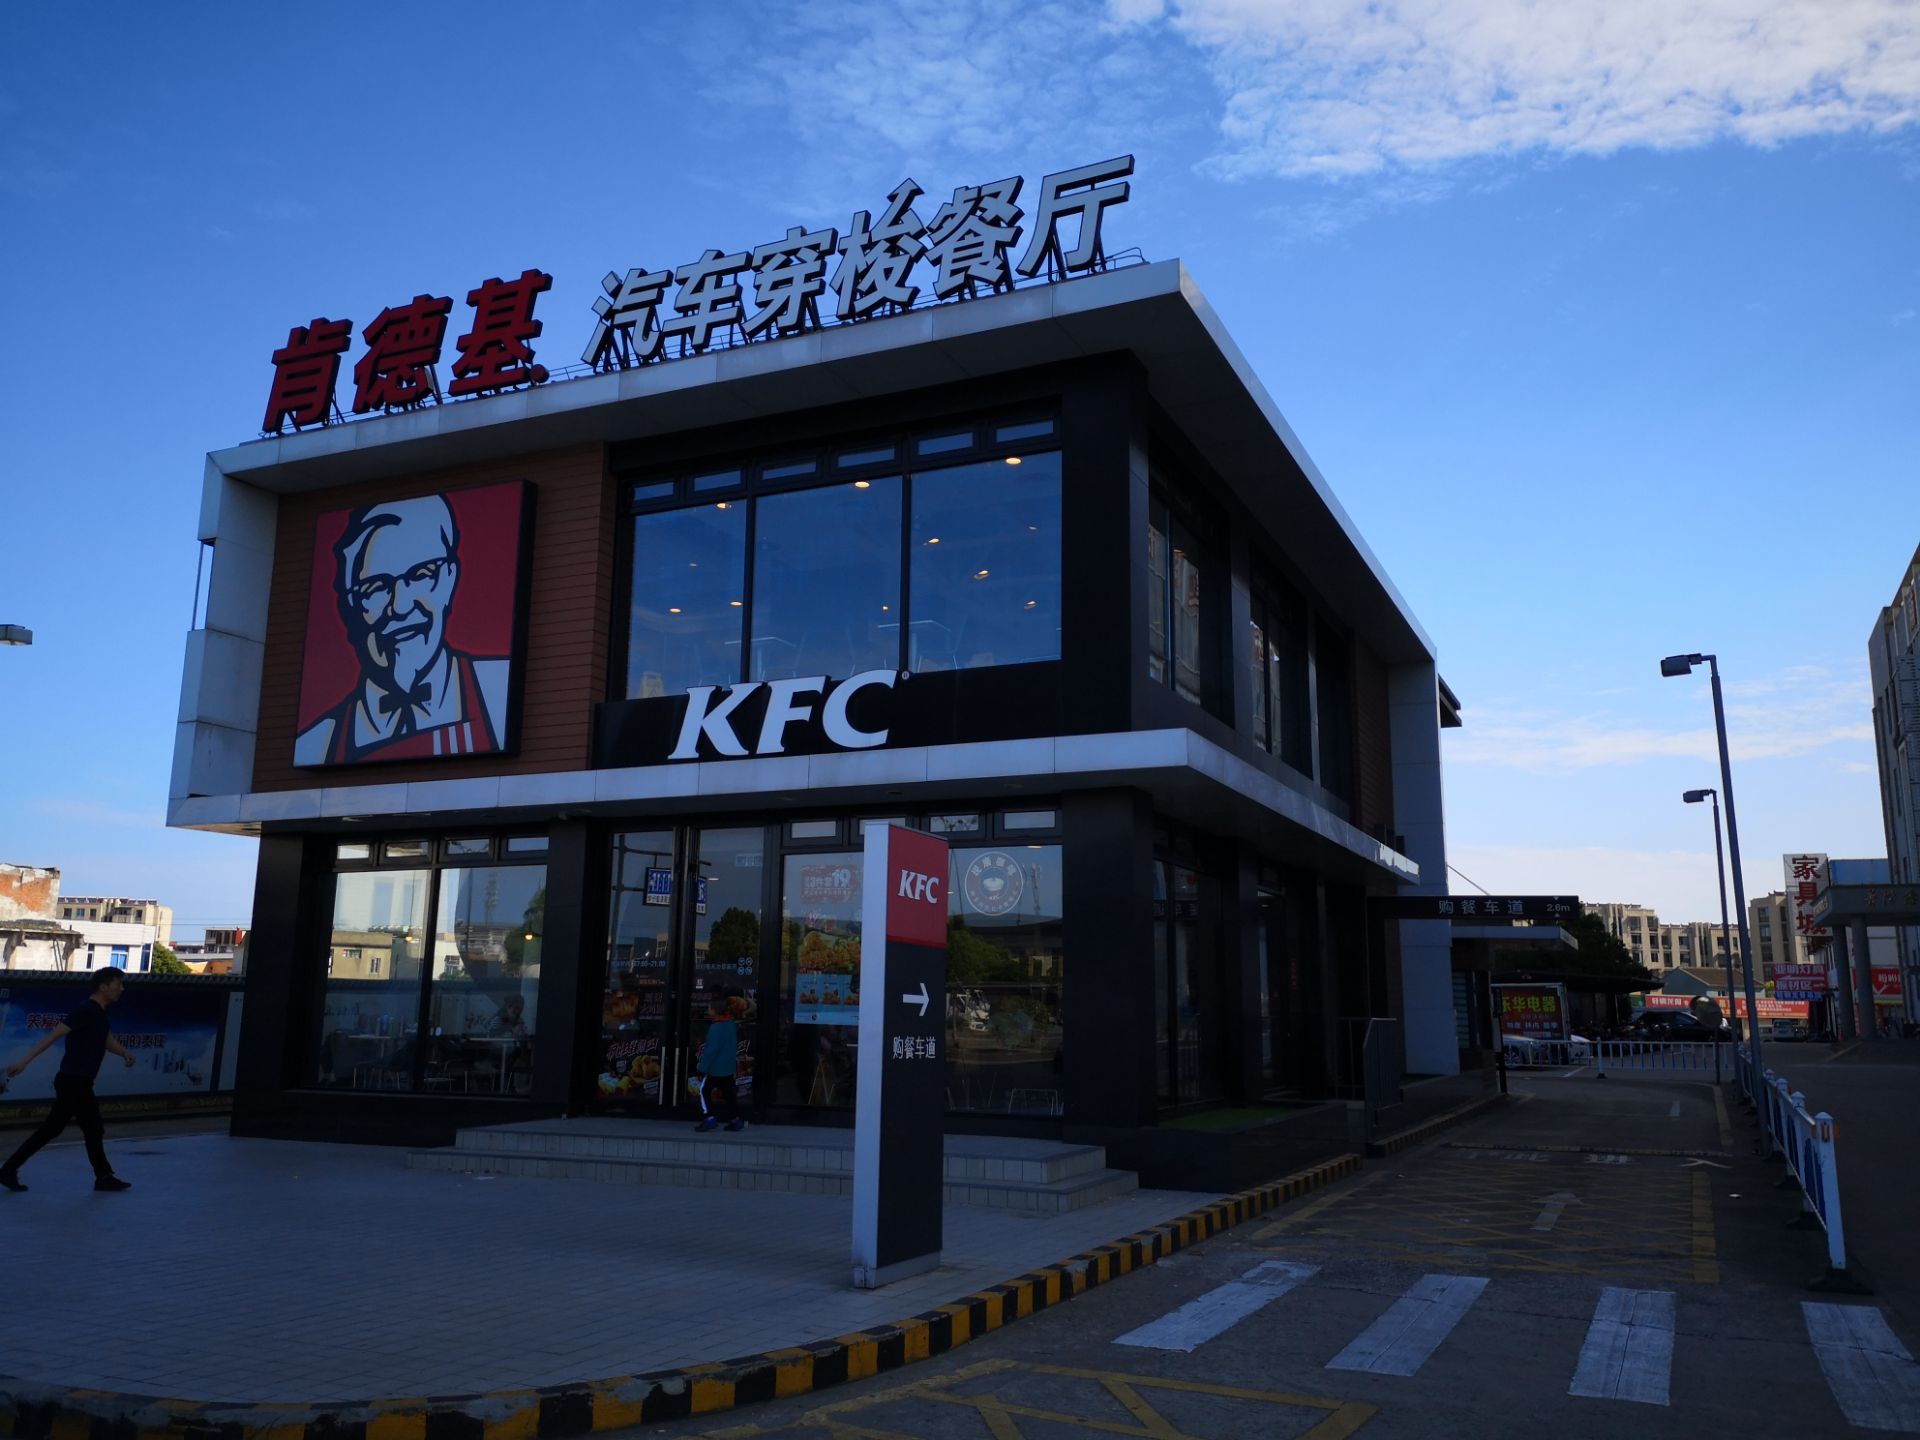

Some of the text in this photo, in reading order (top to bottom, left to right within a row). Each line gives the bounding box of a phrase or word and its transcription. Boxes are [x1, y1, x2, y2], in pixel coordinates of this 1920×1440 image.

[580, 154, 1134, 366] 汽车穿梭餐厅
[262, 268, 553, 433] 肯德基
[667, 669, 898, 760] KFC
[898, 869, 940, 904] KFC
[1438, 899, 1524, 915] 购餐车道
[892, 1035, 937, 1060] 购餐车道
